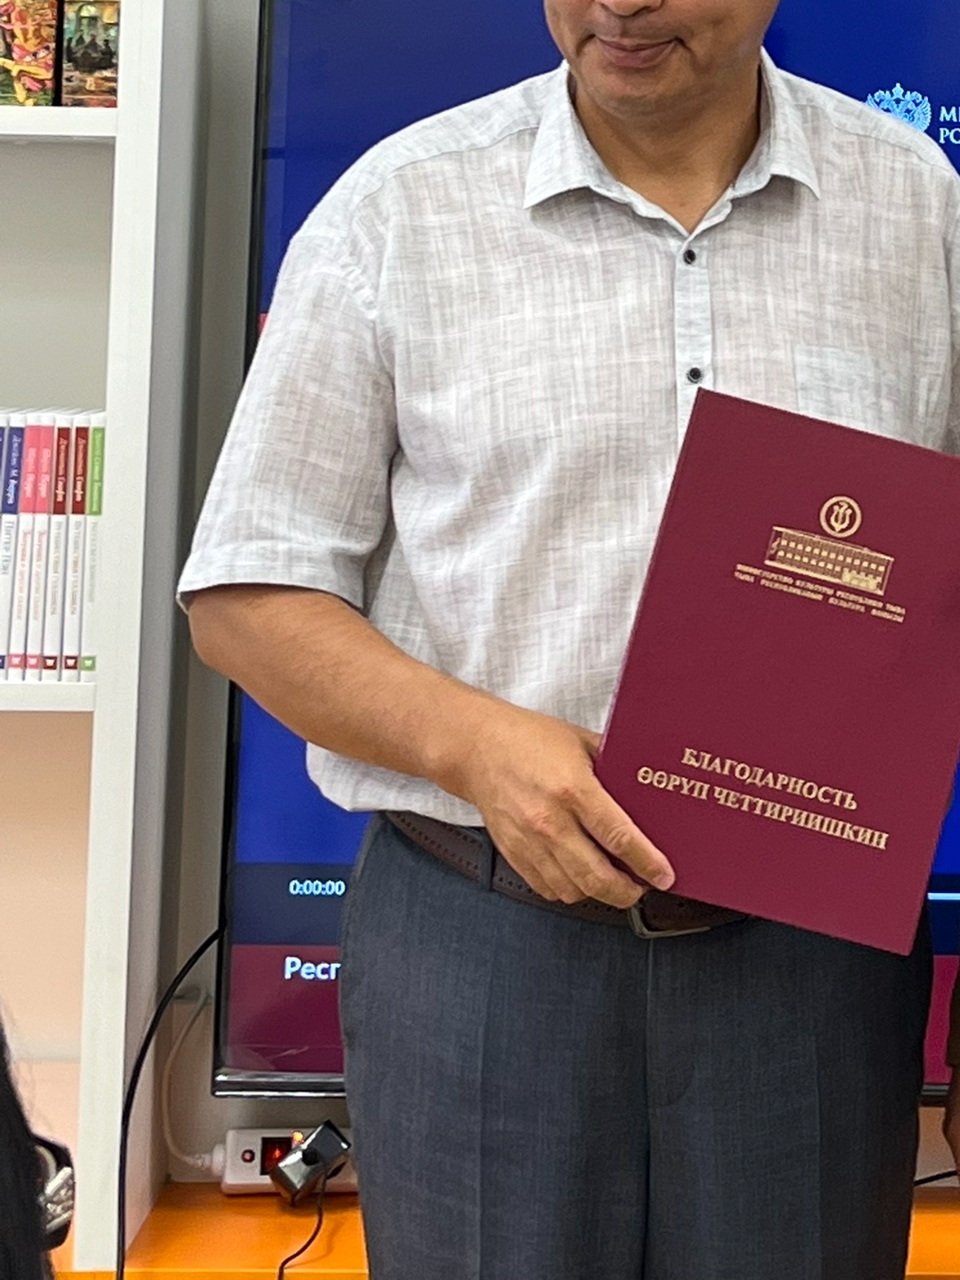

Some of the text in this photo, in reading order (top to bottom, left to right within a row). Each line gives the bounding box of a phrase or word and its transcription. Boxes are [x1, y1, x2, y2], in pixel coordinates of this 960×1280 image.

[681, 747, 858, 810] БЛАГОДАРНОСТЬ
[714, 787, 889, 850] ЧЕТТИРИИШКИН
[289, 879, 346, 896] 0:00:00
